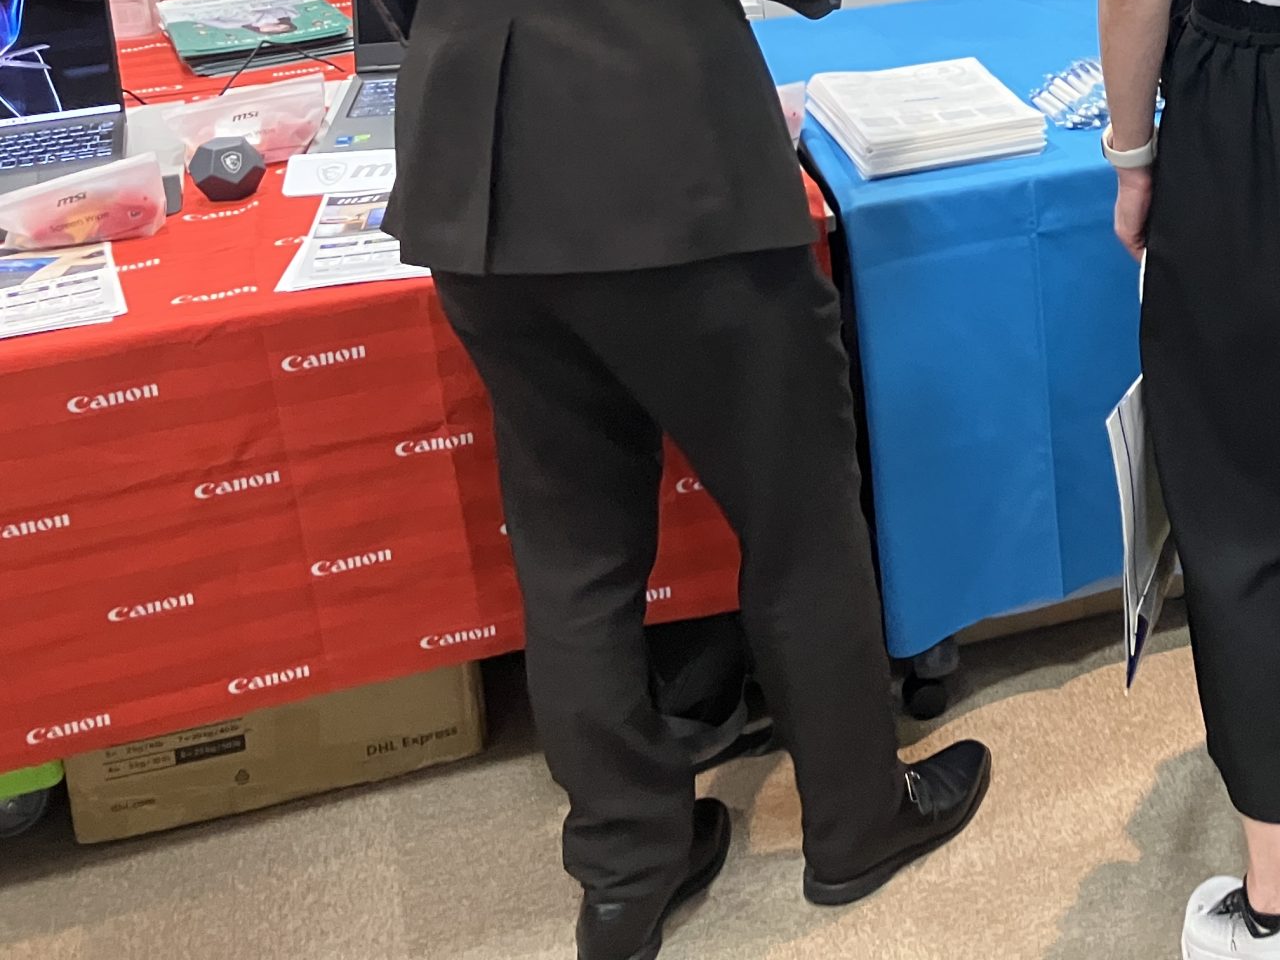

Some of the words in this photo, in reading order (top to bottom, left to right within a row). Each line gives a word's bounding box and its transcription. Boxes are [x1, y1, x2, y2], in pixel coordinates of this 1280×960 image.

[232, 111, 259, 123] msi
[57, 191, 87, 208] msi
[182, 200, 259, 222] Canon
[170, 285, 258, 305] Canon
[281, 345, 366, 372] Canon
[66, 383, 159, 413] Canon
[395, 431, 474, 457] Canon
[194, 470, 280, 499] Canon
[0, 513, 70, 539] anon
[310, 549, 392, 577] Canon
[107, 592, 194, 622] Canon
[419, 625, 496, 649] Canon
[227, 664, 310, 694] Canon
[26, 713, 111, 745] Canon
[366, 739, 398, 757] DHL
[402, 726, 458, 748] Express
